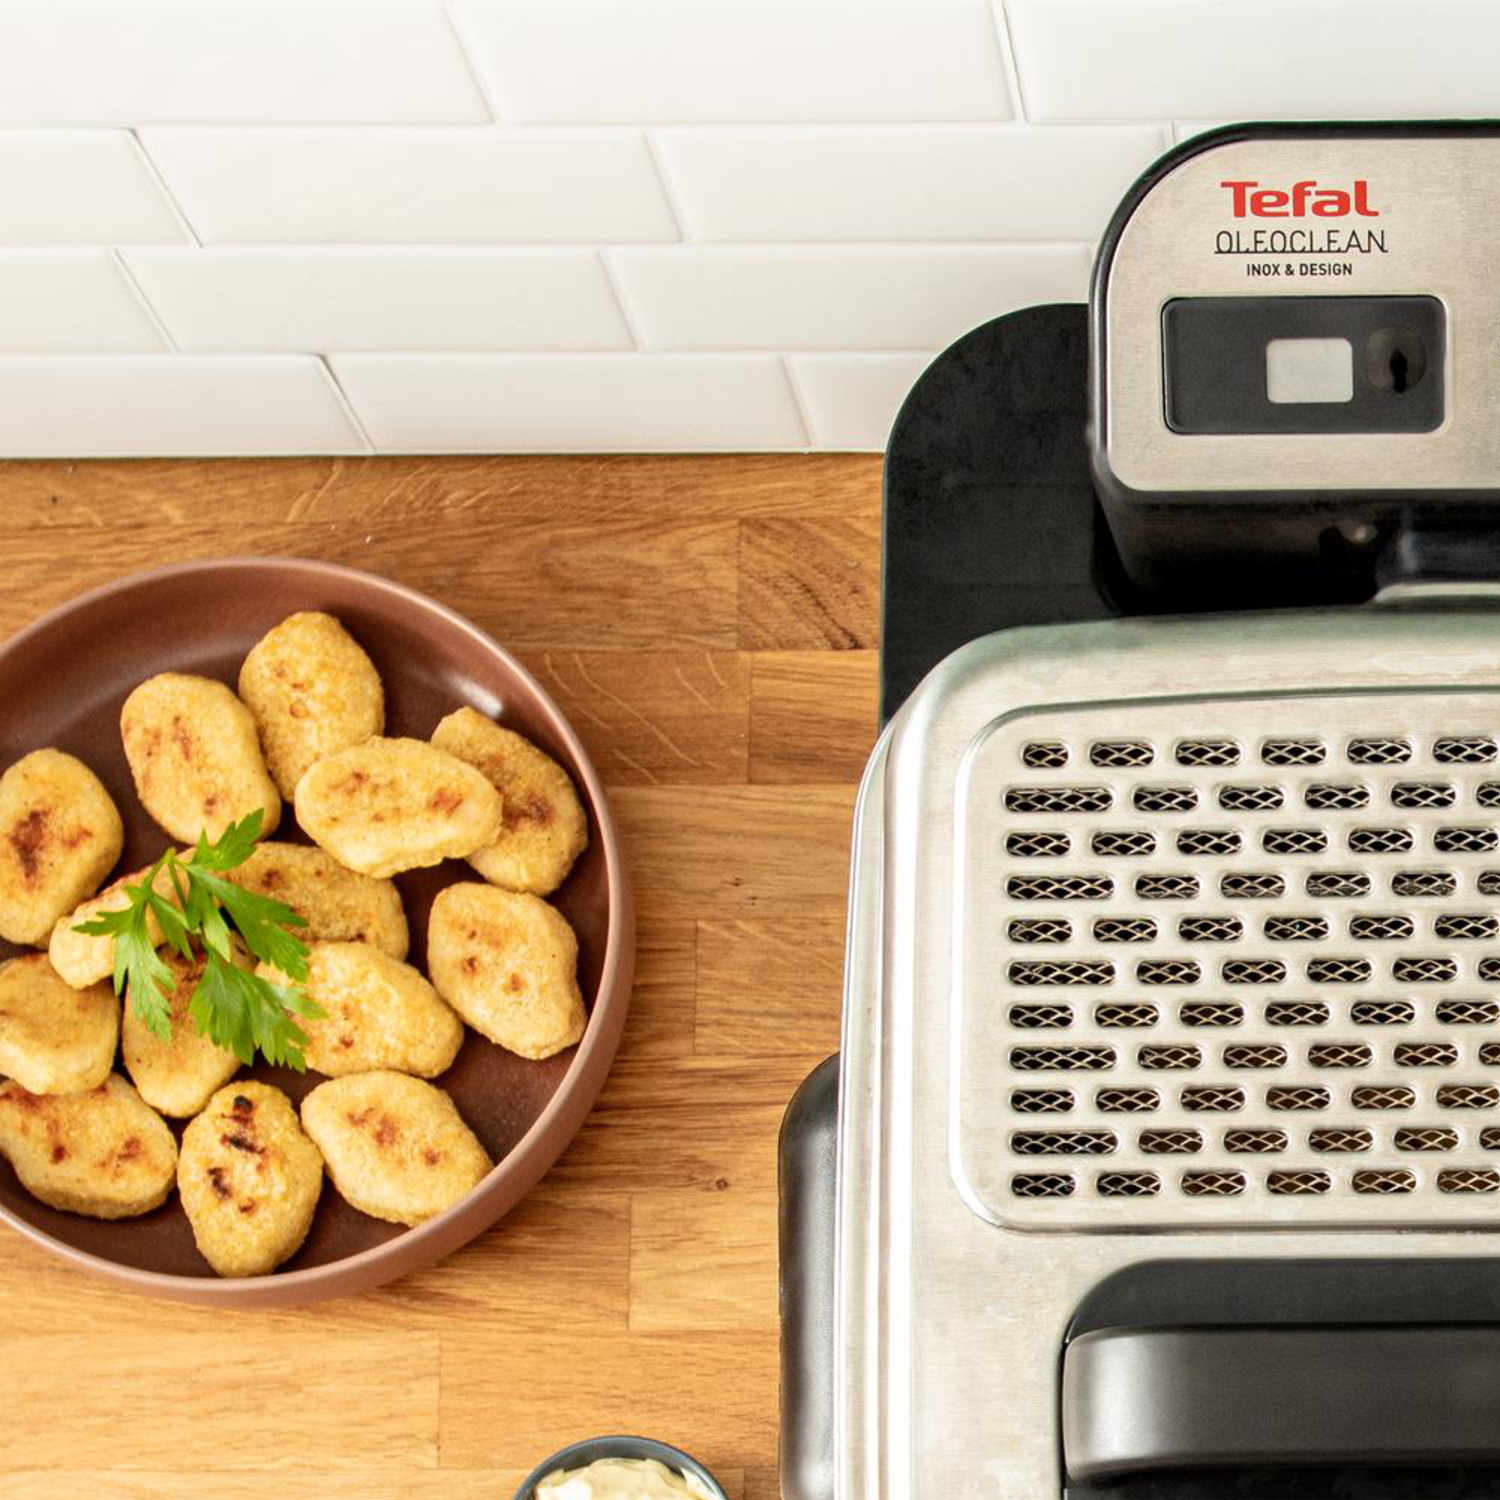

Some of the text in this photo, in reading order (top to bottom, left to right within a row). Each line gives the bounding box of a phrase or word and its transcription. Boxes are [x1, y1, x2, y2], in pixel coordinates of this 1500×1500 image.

[1220, 180, 1380, 218] Tefal
[1214, 229, 1389, 254] OLEOCLEAN
[1246, 263, 1353, 277] INOX & DESIGN
